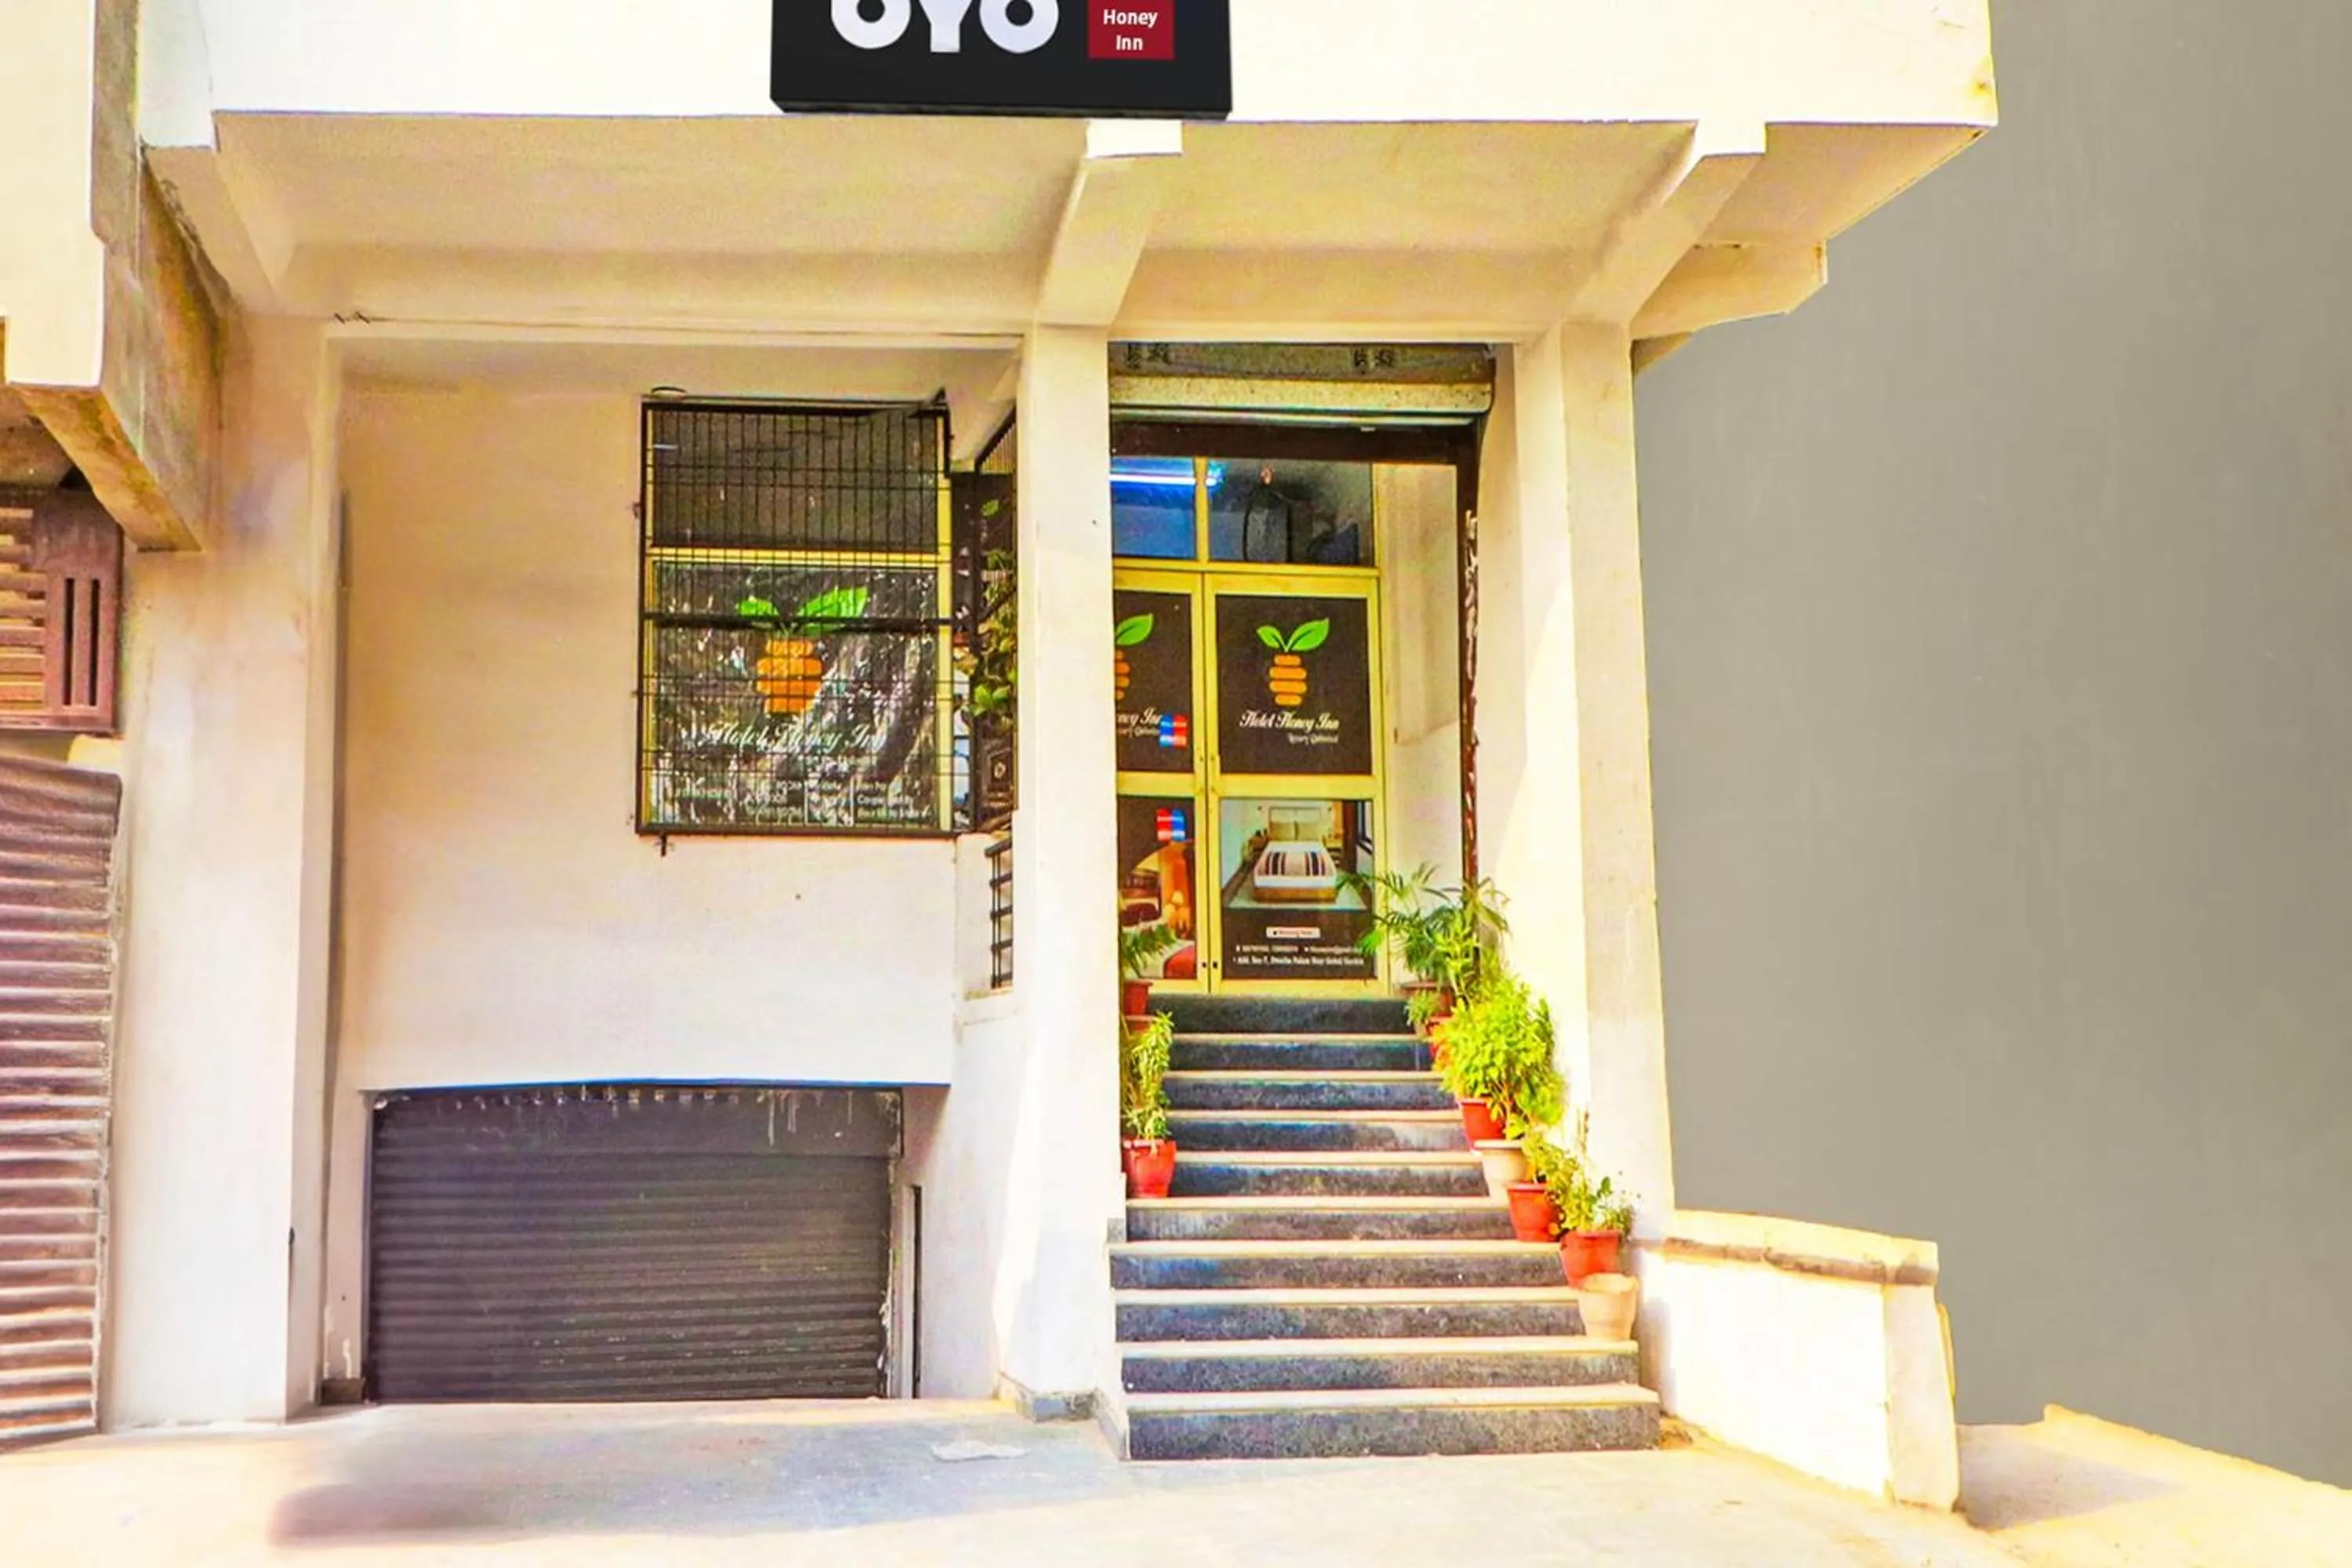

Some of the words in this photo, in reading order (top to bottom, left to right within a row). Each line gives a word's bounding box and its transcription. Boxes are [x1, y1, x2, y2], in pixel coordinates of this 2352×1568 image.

[1103, 9, 1158, 28] Honey
[1116, 34, 1144, 51] Inn
[1240, 710, 1276, 728] Hotel
[1275, 711, 1315, 733] Honey
[1316, 713, 1339, 730] Inn
